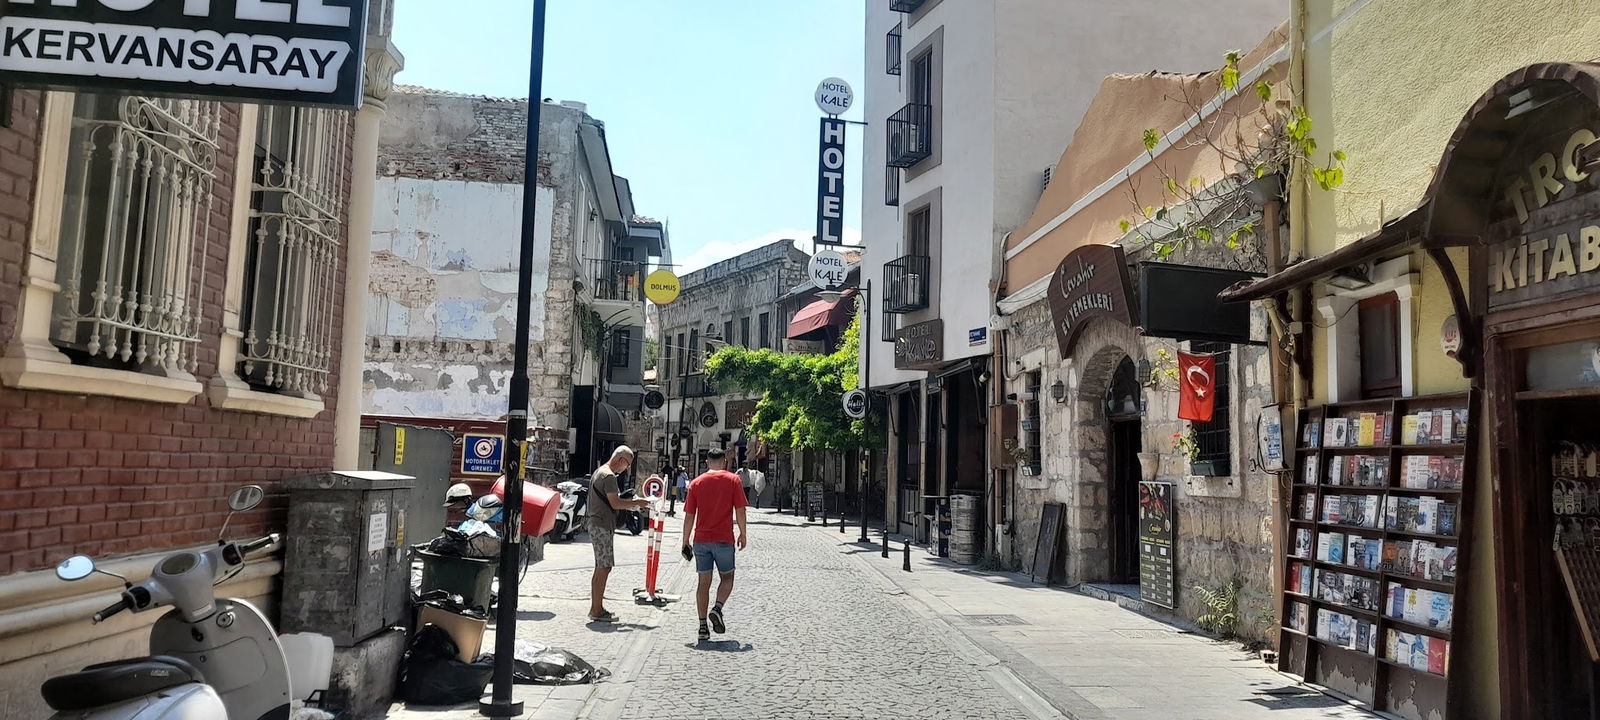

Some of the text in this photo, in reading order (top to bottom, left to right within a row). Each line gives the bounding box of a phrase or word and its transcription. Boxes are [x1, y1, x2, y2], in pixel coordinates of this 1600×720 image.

[3, 26, 338, 79] KERVANSARAY
[822, 82, 848, 93] HOTEL
[821, 94, 849, 108] KALE
[822, 122, 844, 243] HOTEL
[816, 256, 843, 267] HOTEL
[814, 268, 843, 281] KALE
[650, 283, 677, 292] DOLMUŞ
[1061, 292, 1113, 336] EV YEMEKLERİ
